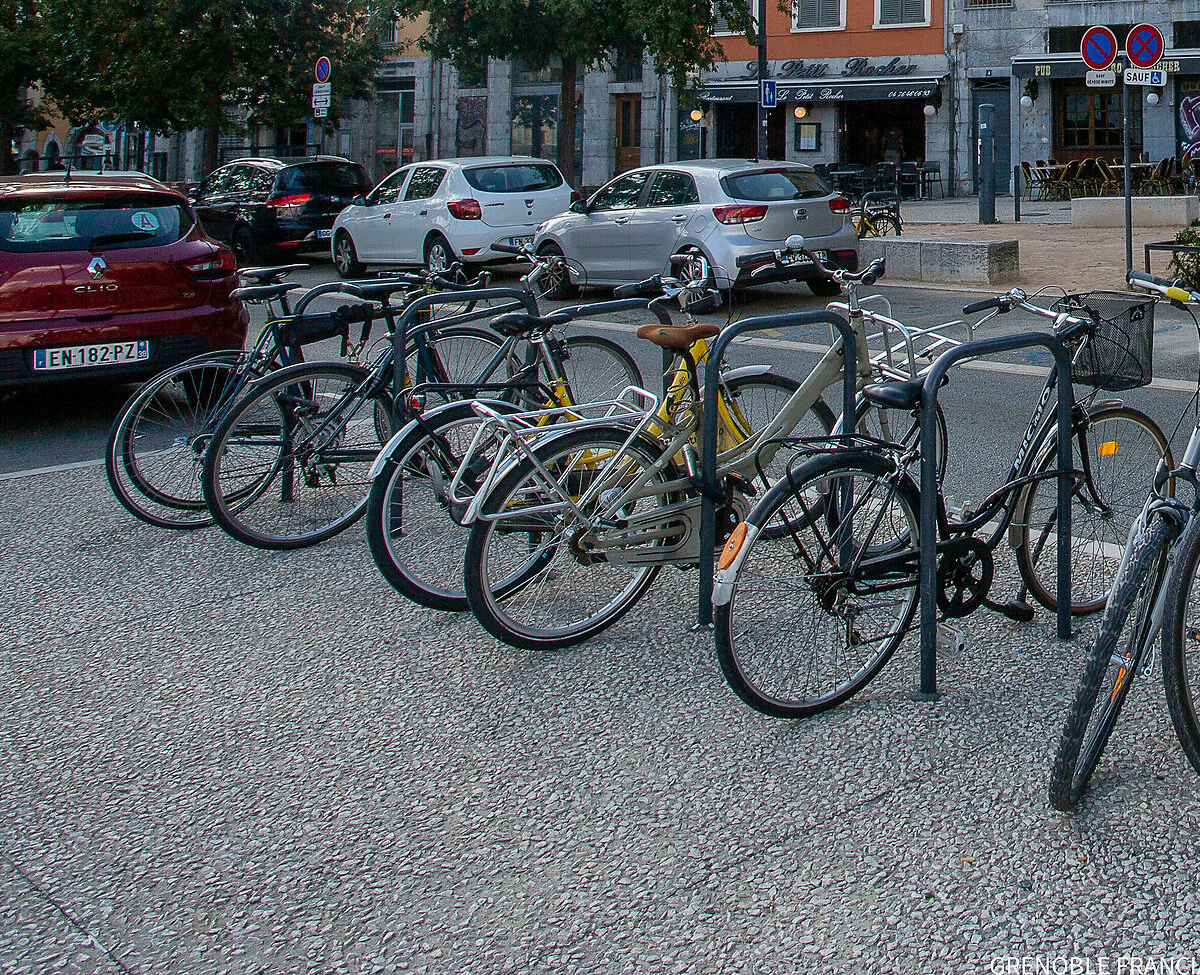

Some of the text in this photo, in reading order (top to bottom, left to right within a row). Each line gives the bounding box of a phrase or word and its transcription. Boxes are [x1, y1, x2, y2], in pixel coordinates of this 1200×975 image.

[777, 60, 829, 77] Petit
[841, 57, 918, 76] Rocher
[1034, 65, 1051, 76] PUB
[1153, 60, 1180, 71] CHER
[1126, 73, 1150, 82] SAUF
[795, 88, 813, 100] Petit
[819, 88, 845, 99] Rocher
[140, 214, 154, 229] A
[74, 283, 118, 293] CLIO
[50, 343, 136, 367] EN-182-PZ
[138, 349, 147, 358] 38
